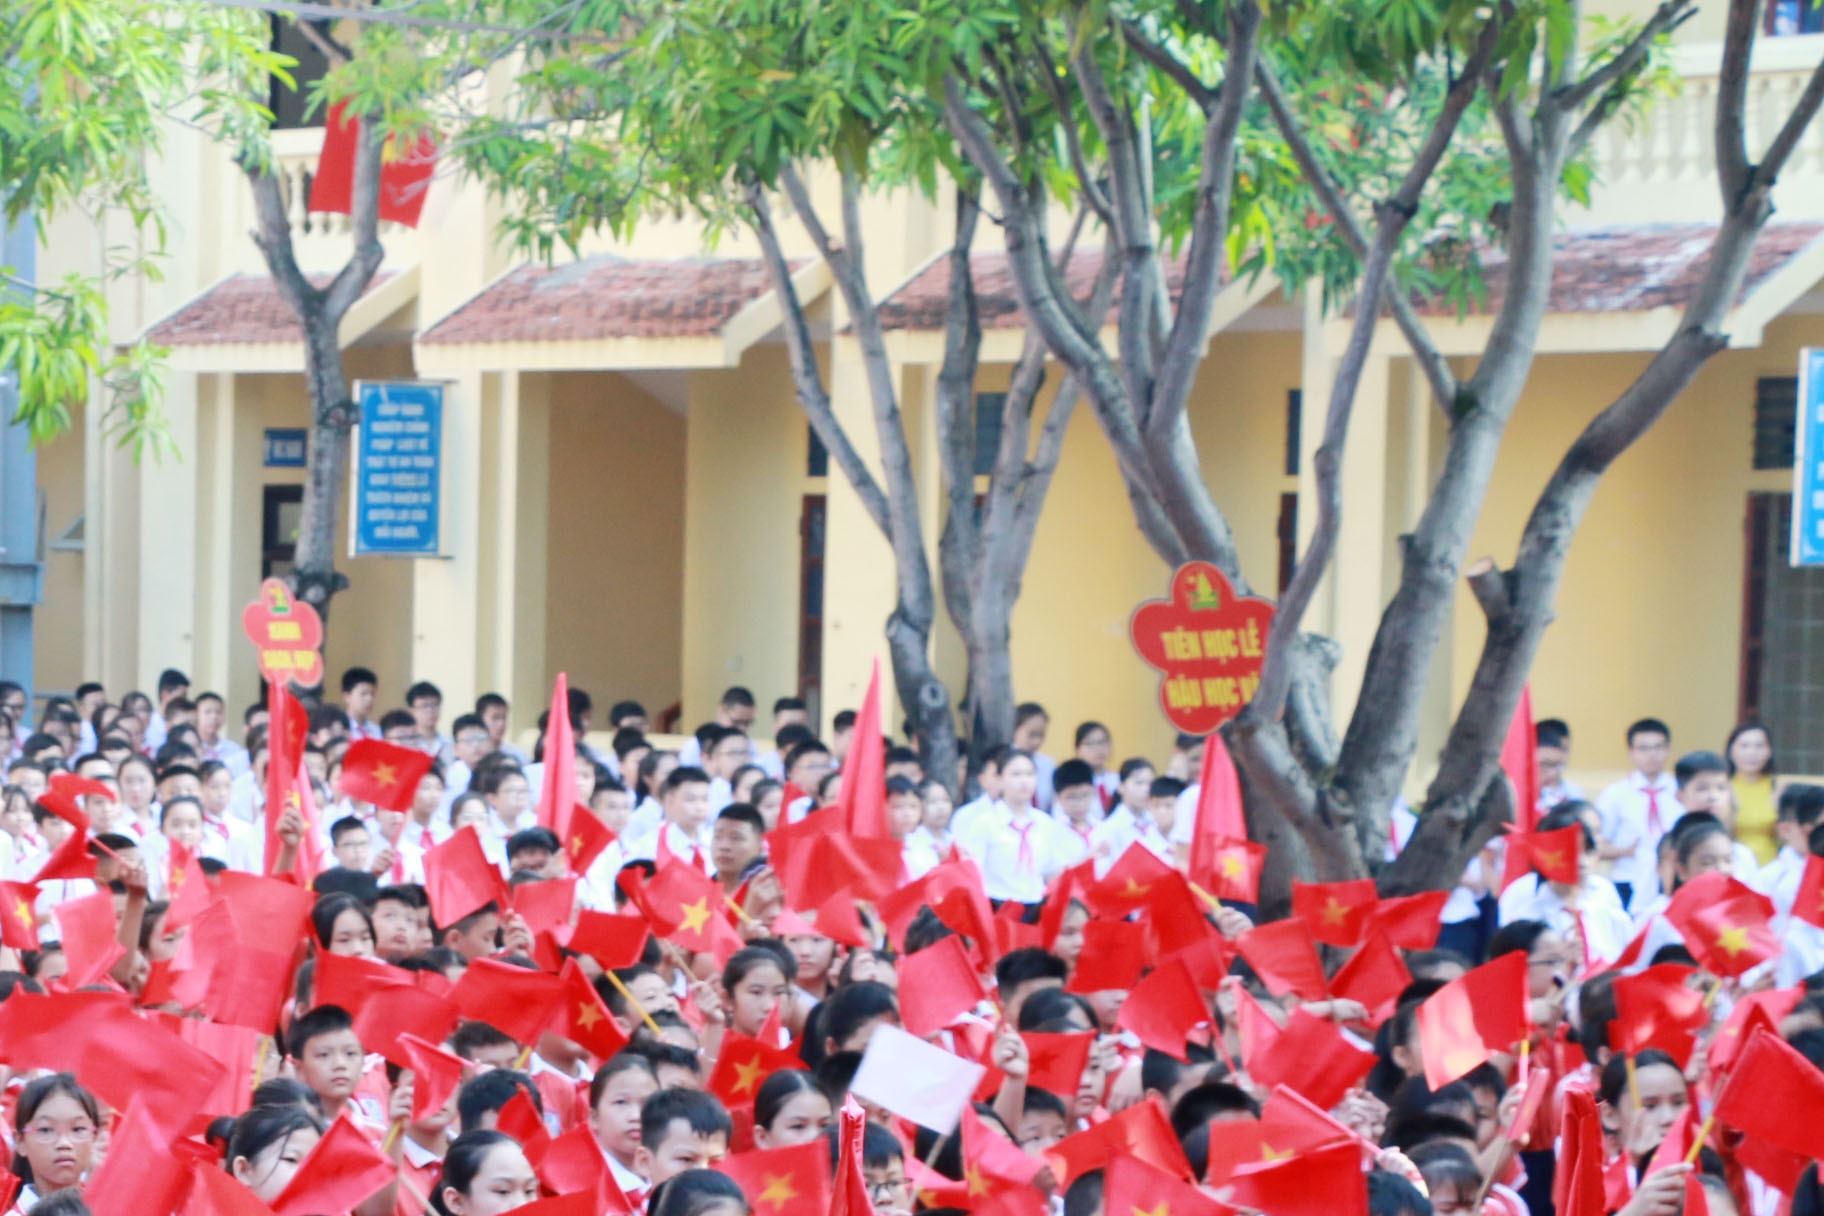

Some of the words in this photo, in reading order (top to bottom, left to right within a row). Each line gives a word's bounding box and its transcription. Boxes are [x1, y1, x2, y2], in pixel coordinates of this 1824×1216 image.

[1158, 625, 1203, 660] TIÊN
[1201, 628, 1239, 664] HỌC
[1237, 616, 1263, 657] LỄ
[1202, 676, 1241, 712] HỌC
